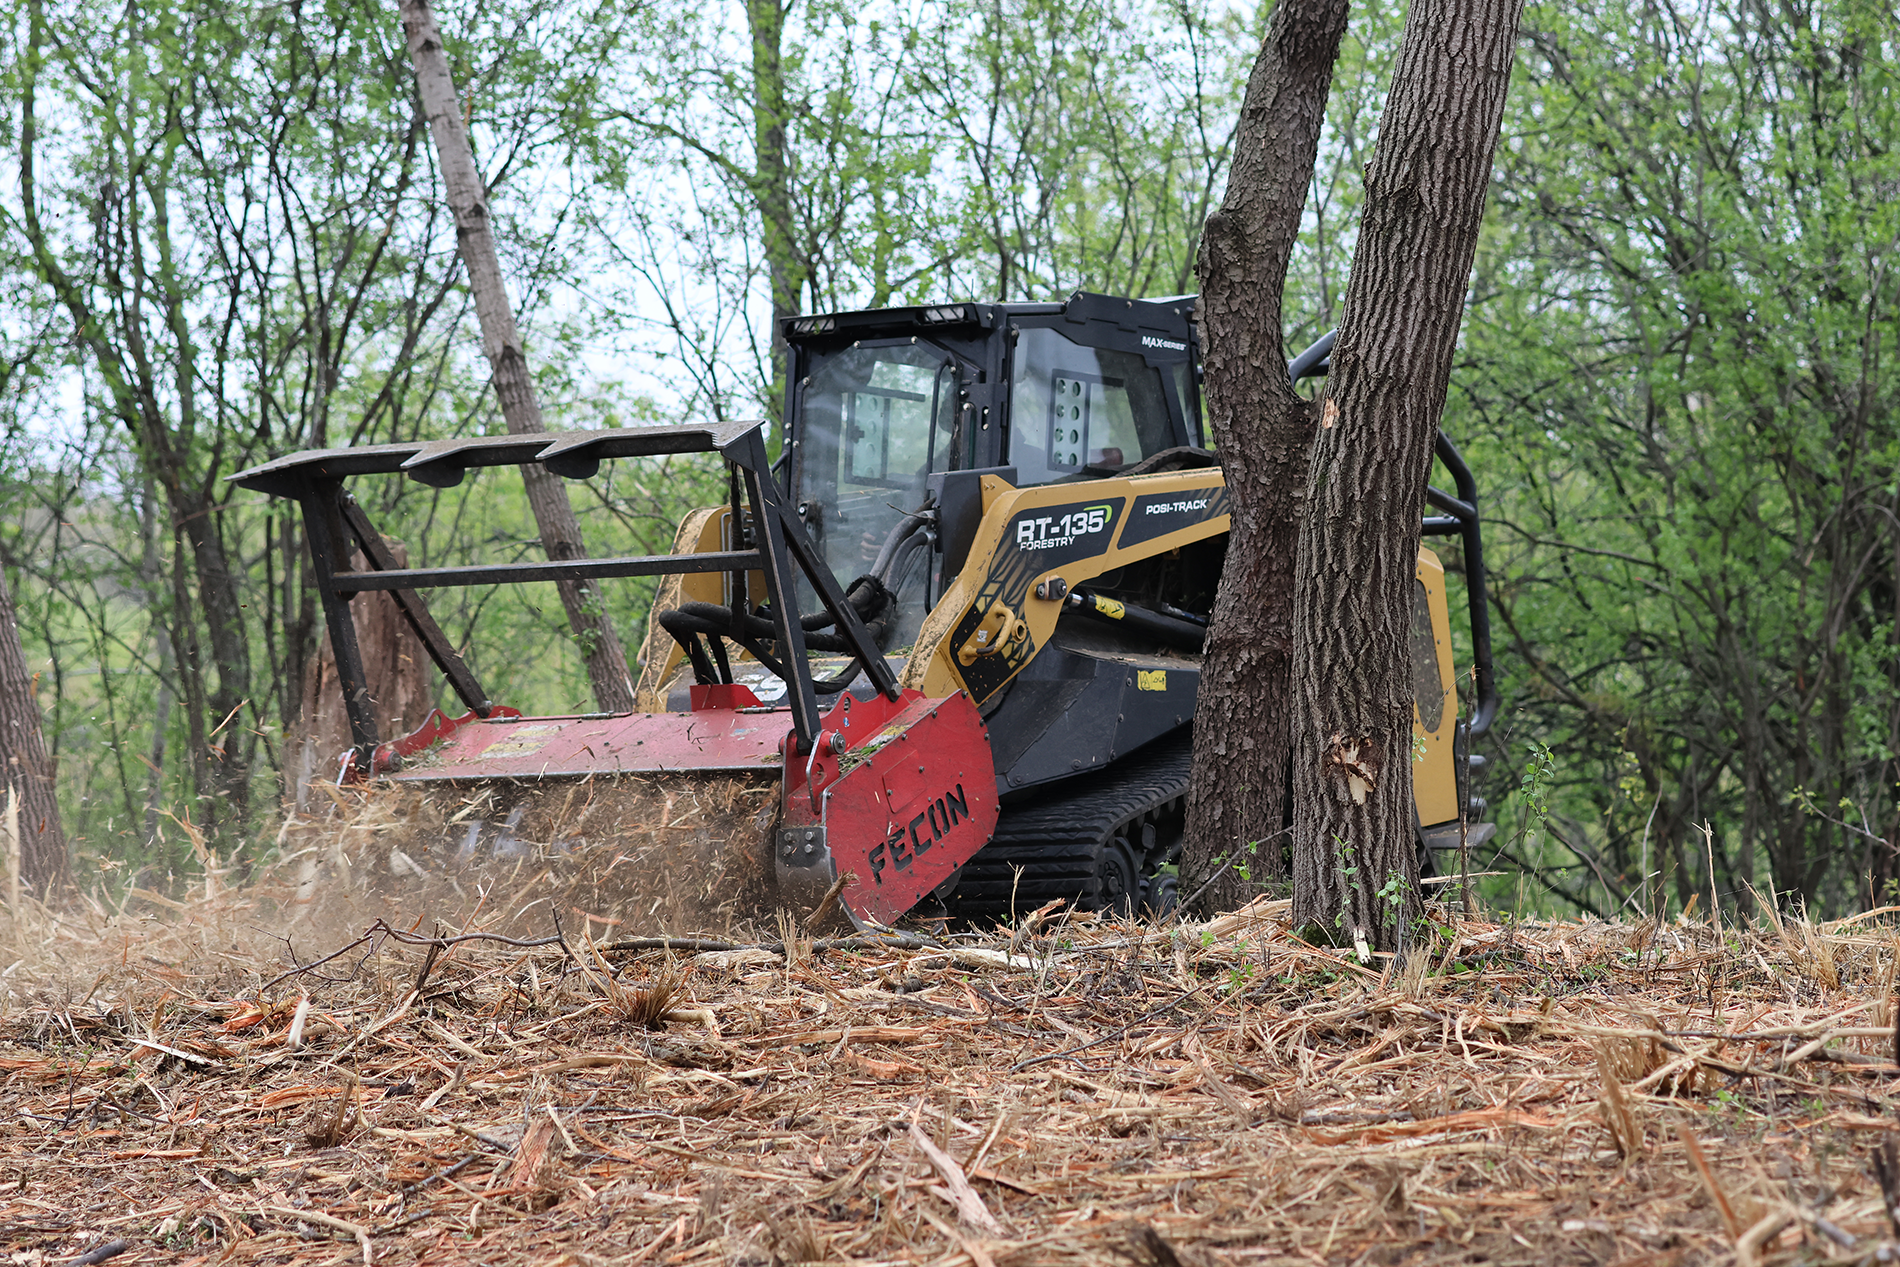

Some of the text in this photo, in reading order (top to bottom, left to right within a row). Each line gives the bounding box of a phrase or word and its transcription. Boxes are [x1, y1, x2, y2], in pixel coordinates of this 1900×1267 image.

[1145, 498, 1208, 516] POSI-TRACK
[1016, 509, 1105, 544] RT-135
[1019, 535, 1076, 552] FORESTRY
[868, 783, 969, 889] FECON
